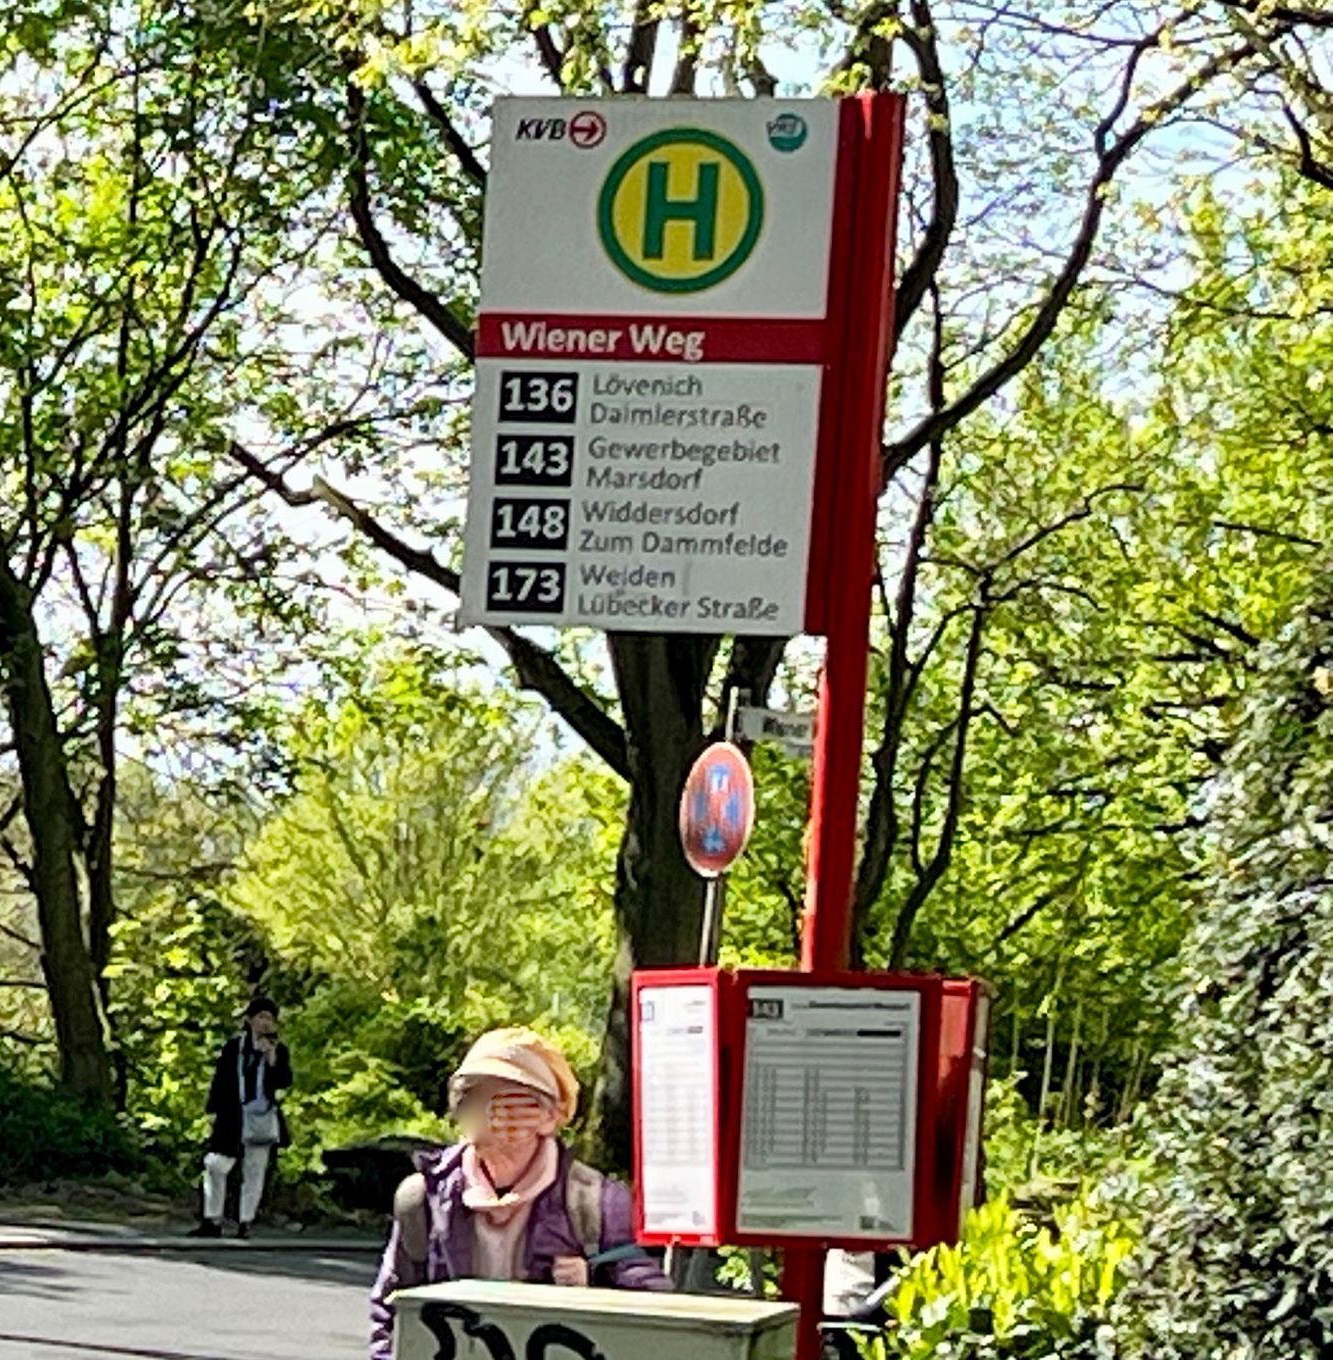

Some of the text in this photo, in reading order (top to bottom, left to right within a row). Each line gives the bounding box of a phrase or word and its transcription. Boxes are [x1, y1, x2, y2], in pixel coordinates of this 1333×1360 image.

[515, 118, 567, 140] KVB
[642, 161, 720, 261] H
[501, 322, 705, 361] Wiener Weg
[503, 373, 703, 414] 136 Lövenich
[589, 402, 768, 429] Daimlerstraße
[499, 437, 780, 477] 143 Gewerbegebiet
[585, 467, 703, 490] Marsdorf
[495, 500, 739, 539] 148 Widdersdorf
[578, 532, 789, 557] Zum Dammfelde
[491, 564, 676, 603] 173 Weiden
[577, 589, 779, 622] Lübecker Straße
